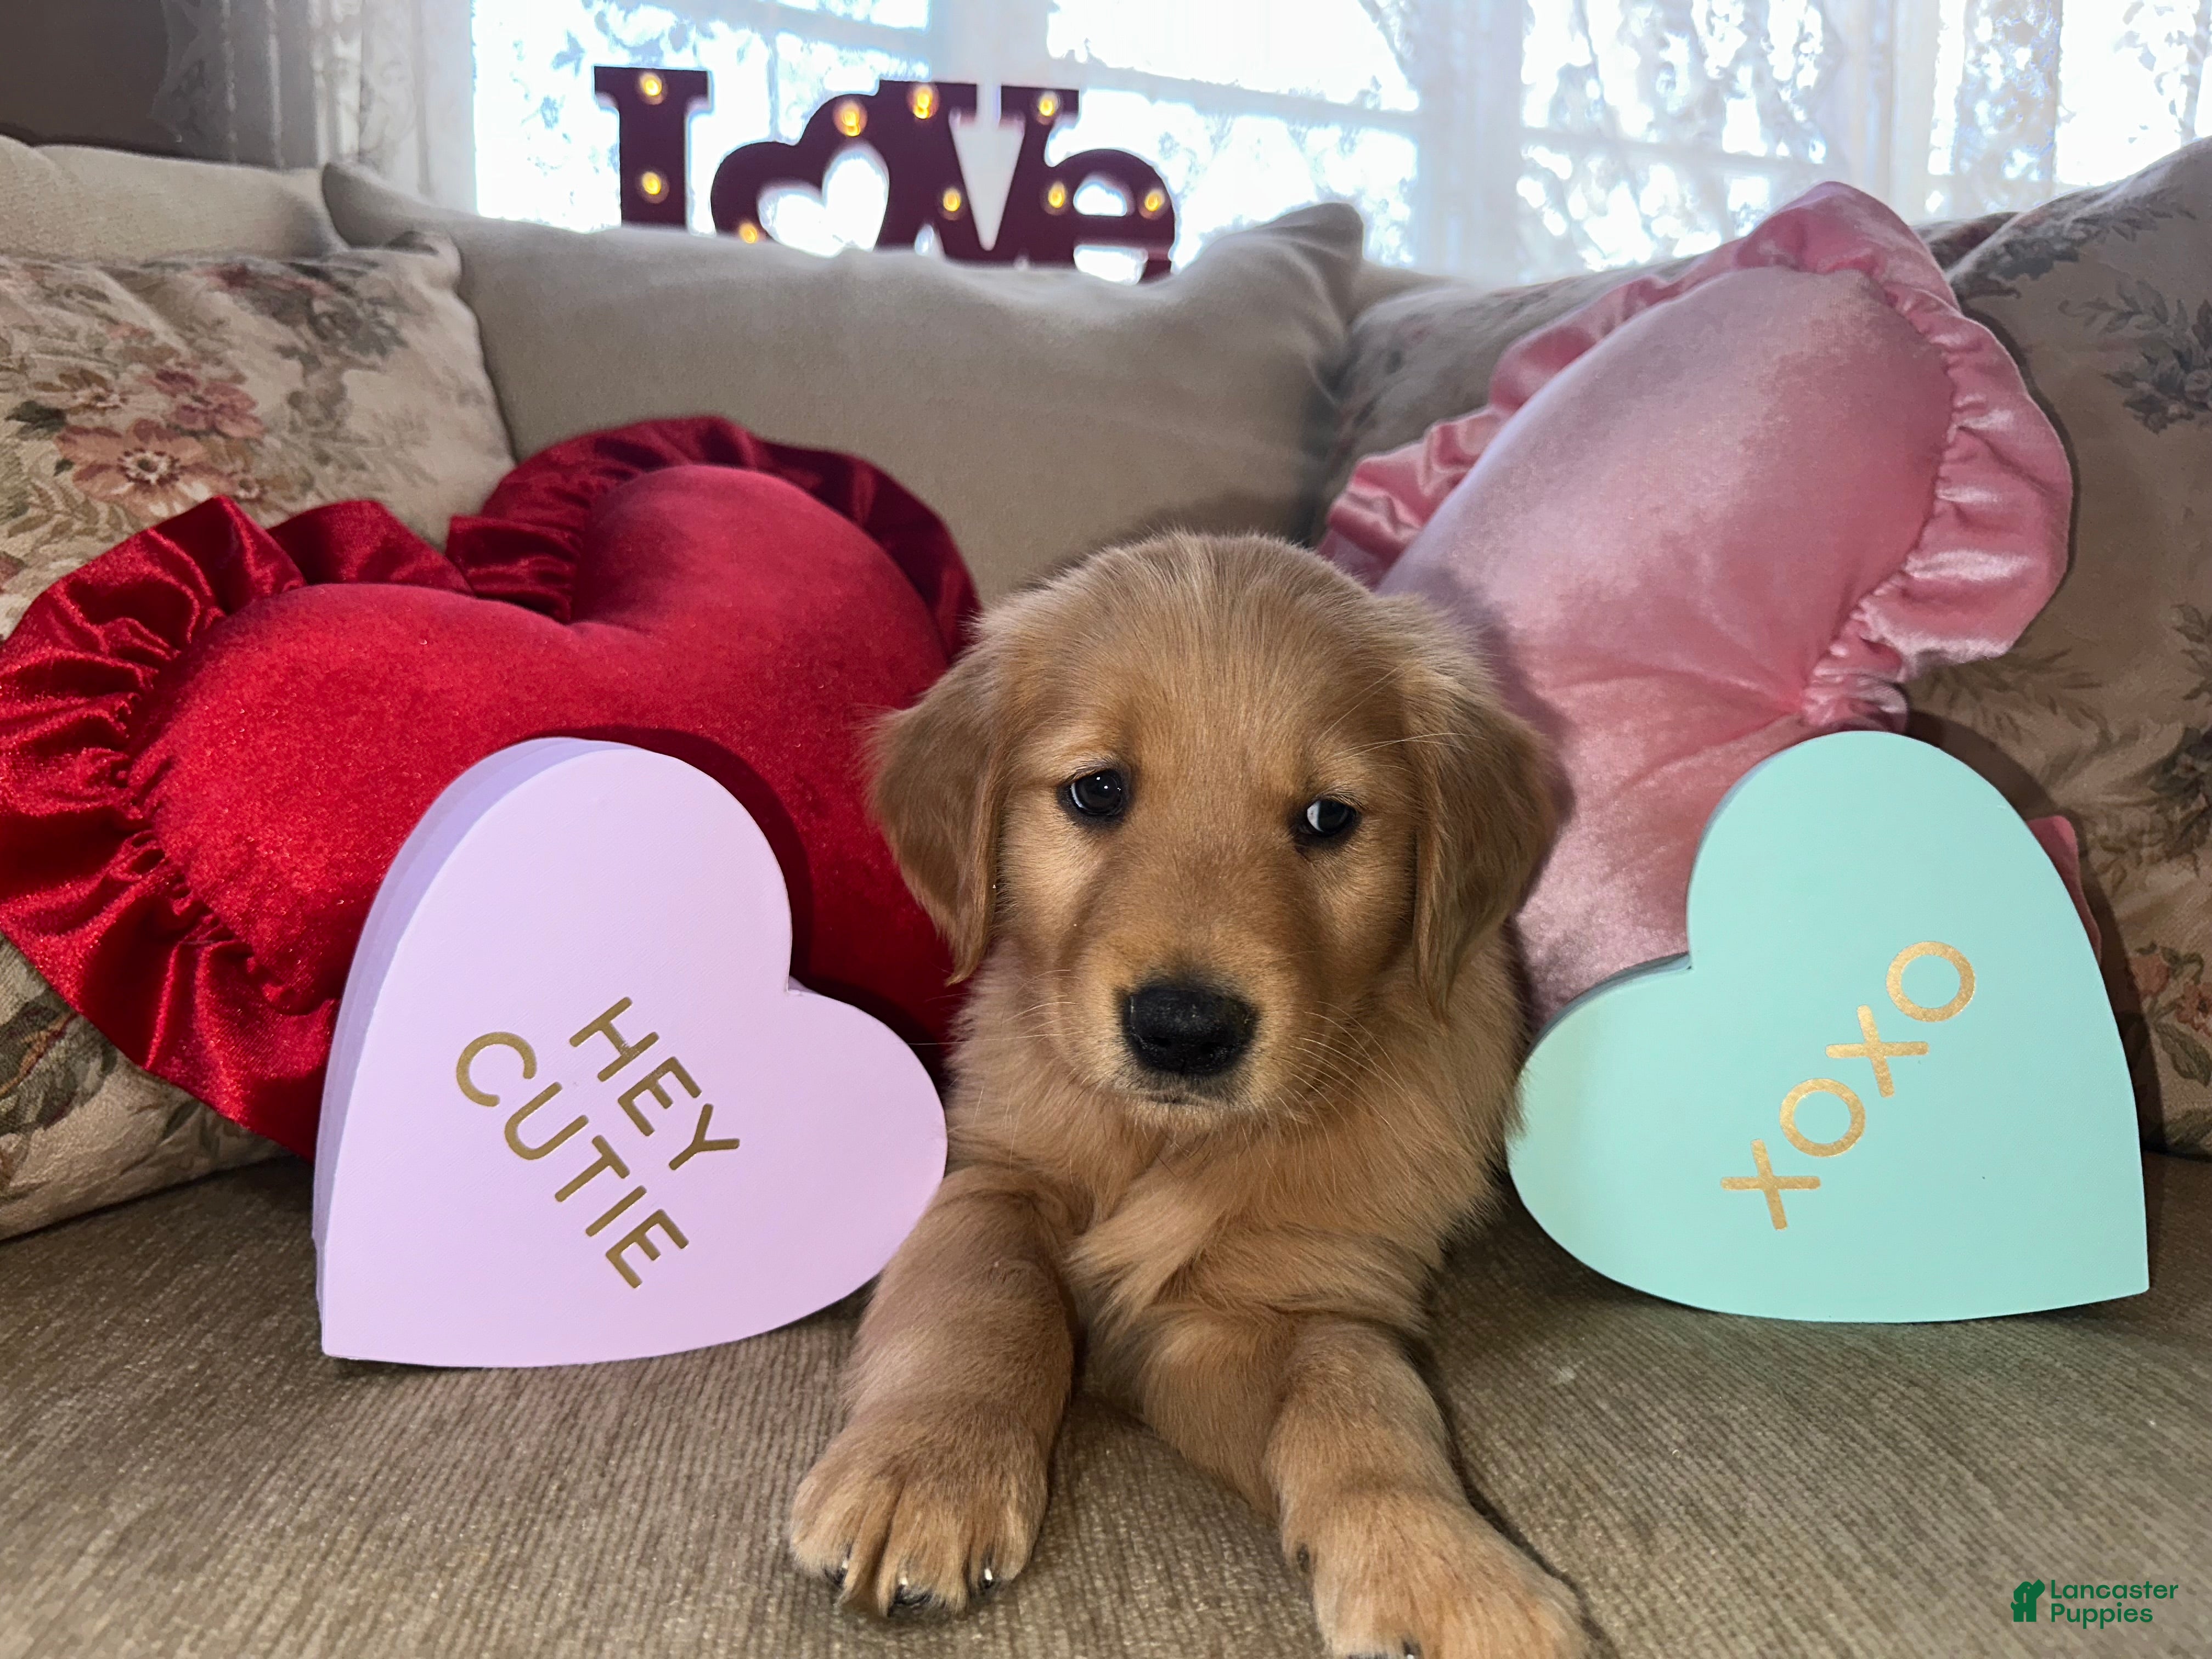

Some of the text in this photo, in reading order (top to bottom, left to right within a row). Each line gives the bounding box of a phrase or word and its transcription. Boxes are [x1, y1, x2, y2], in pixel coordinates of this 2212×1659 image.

[455, 1031, 690, 1289] CUTIE
[569, 996, 741, 1171] HEY
[1719, 940, 1976, 1231] XOXO
